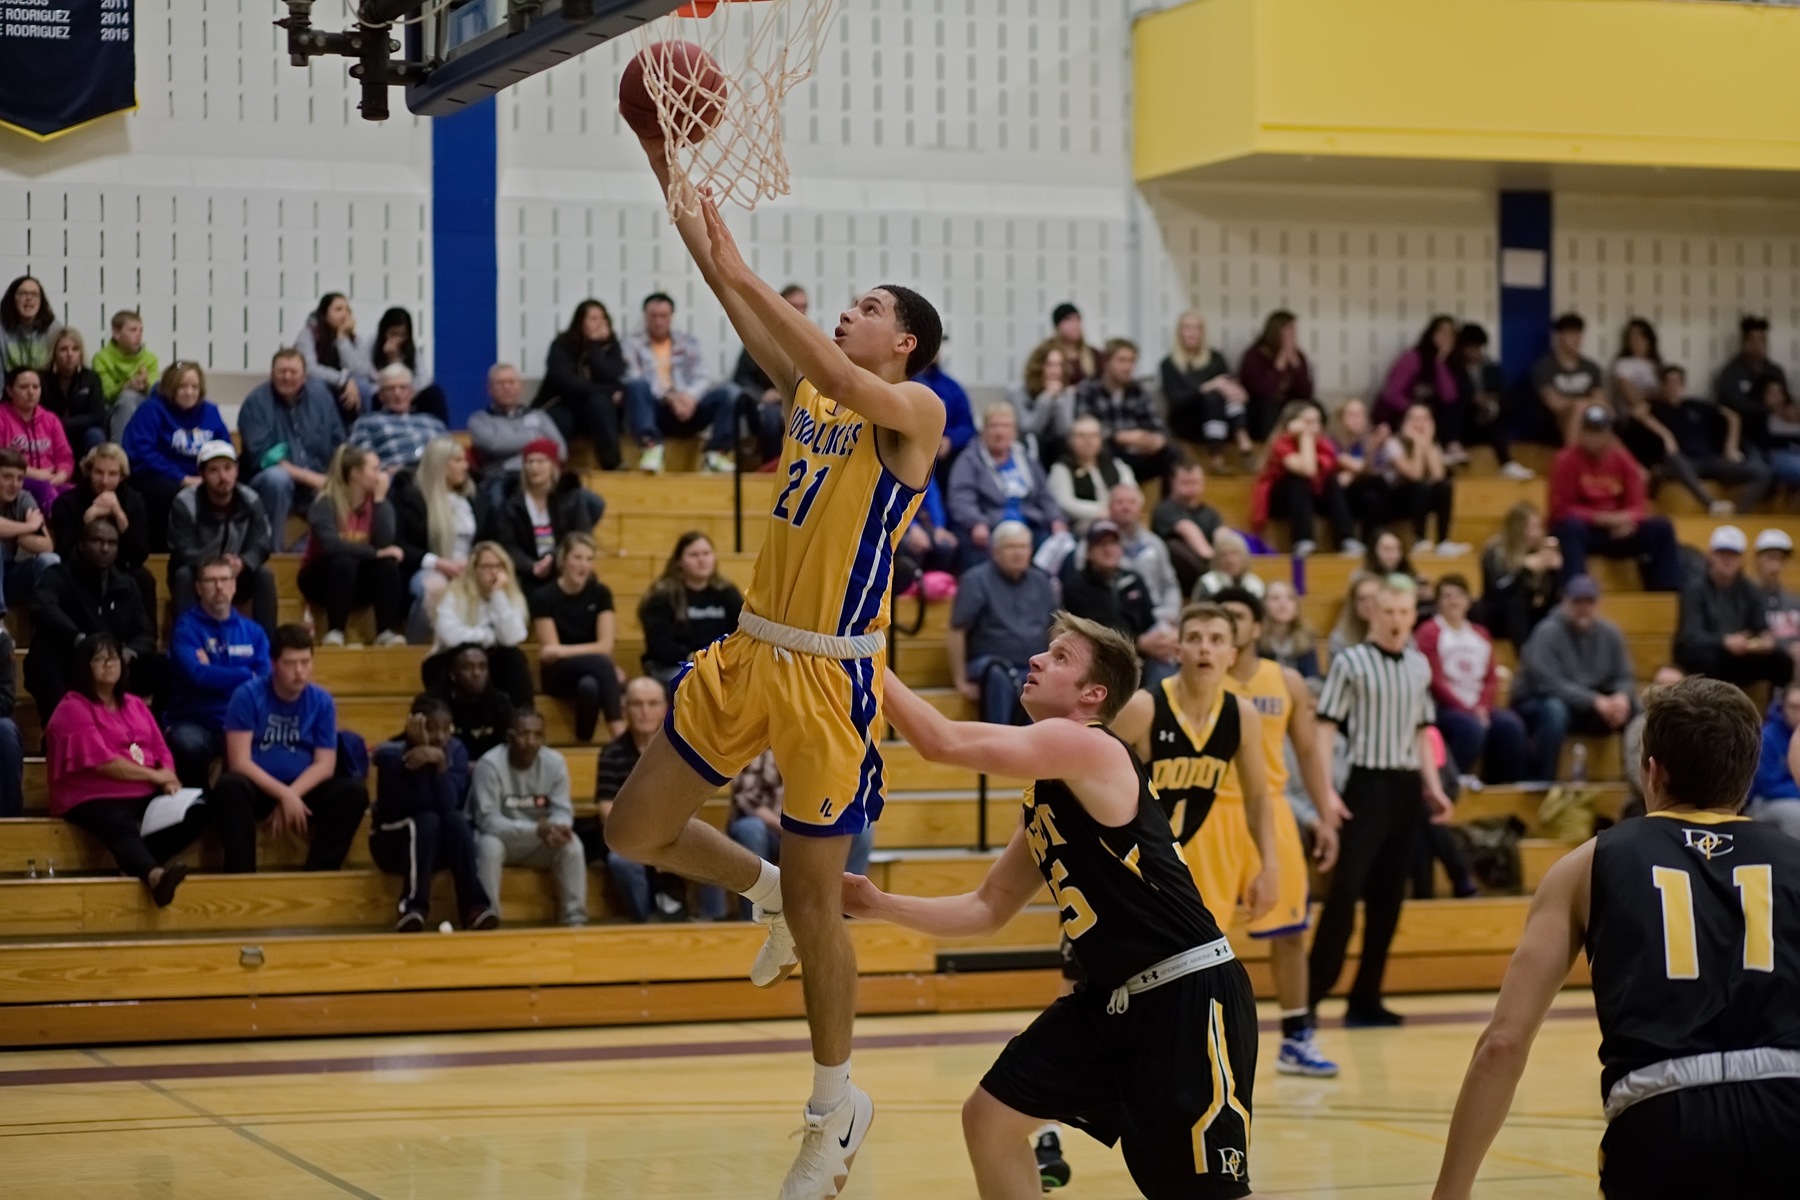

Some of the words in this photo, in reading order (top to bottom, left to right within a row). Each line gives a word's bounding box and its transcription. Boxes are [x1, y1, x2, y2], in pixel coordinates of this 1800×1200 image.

[5, 8, 71, 23] RODRIGUEZ
[100, 11, 129, 25] 2014
[5, 23, 71, 39] RODRIGUEZ
[100, 27, 130, 41] 2015
[772, 457, 831, 529] 21
[1652, 863, 1775, 980] 11
